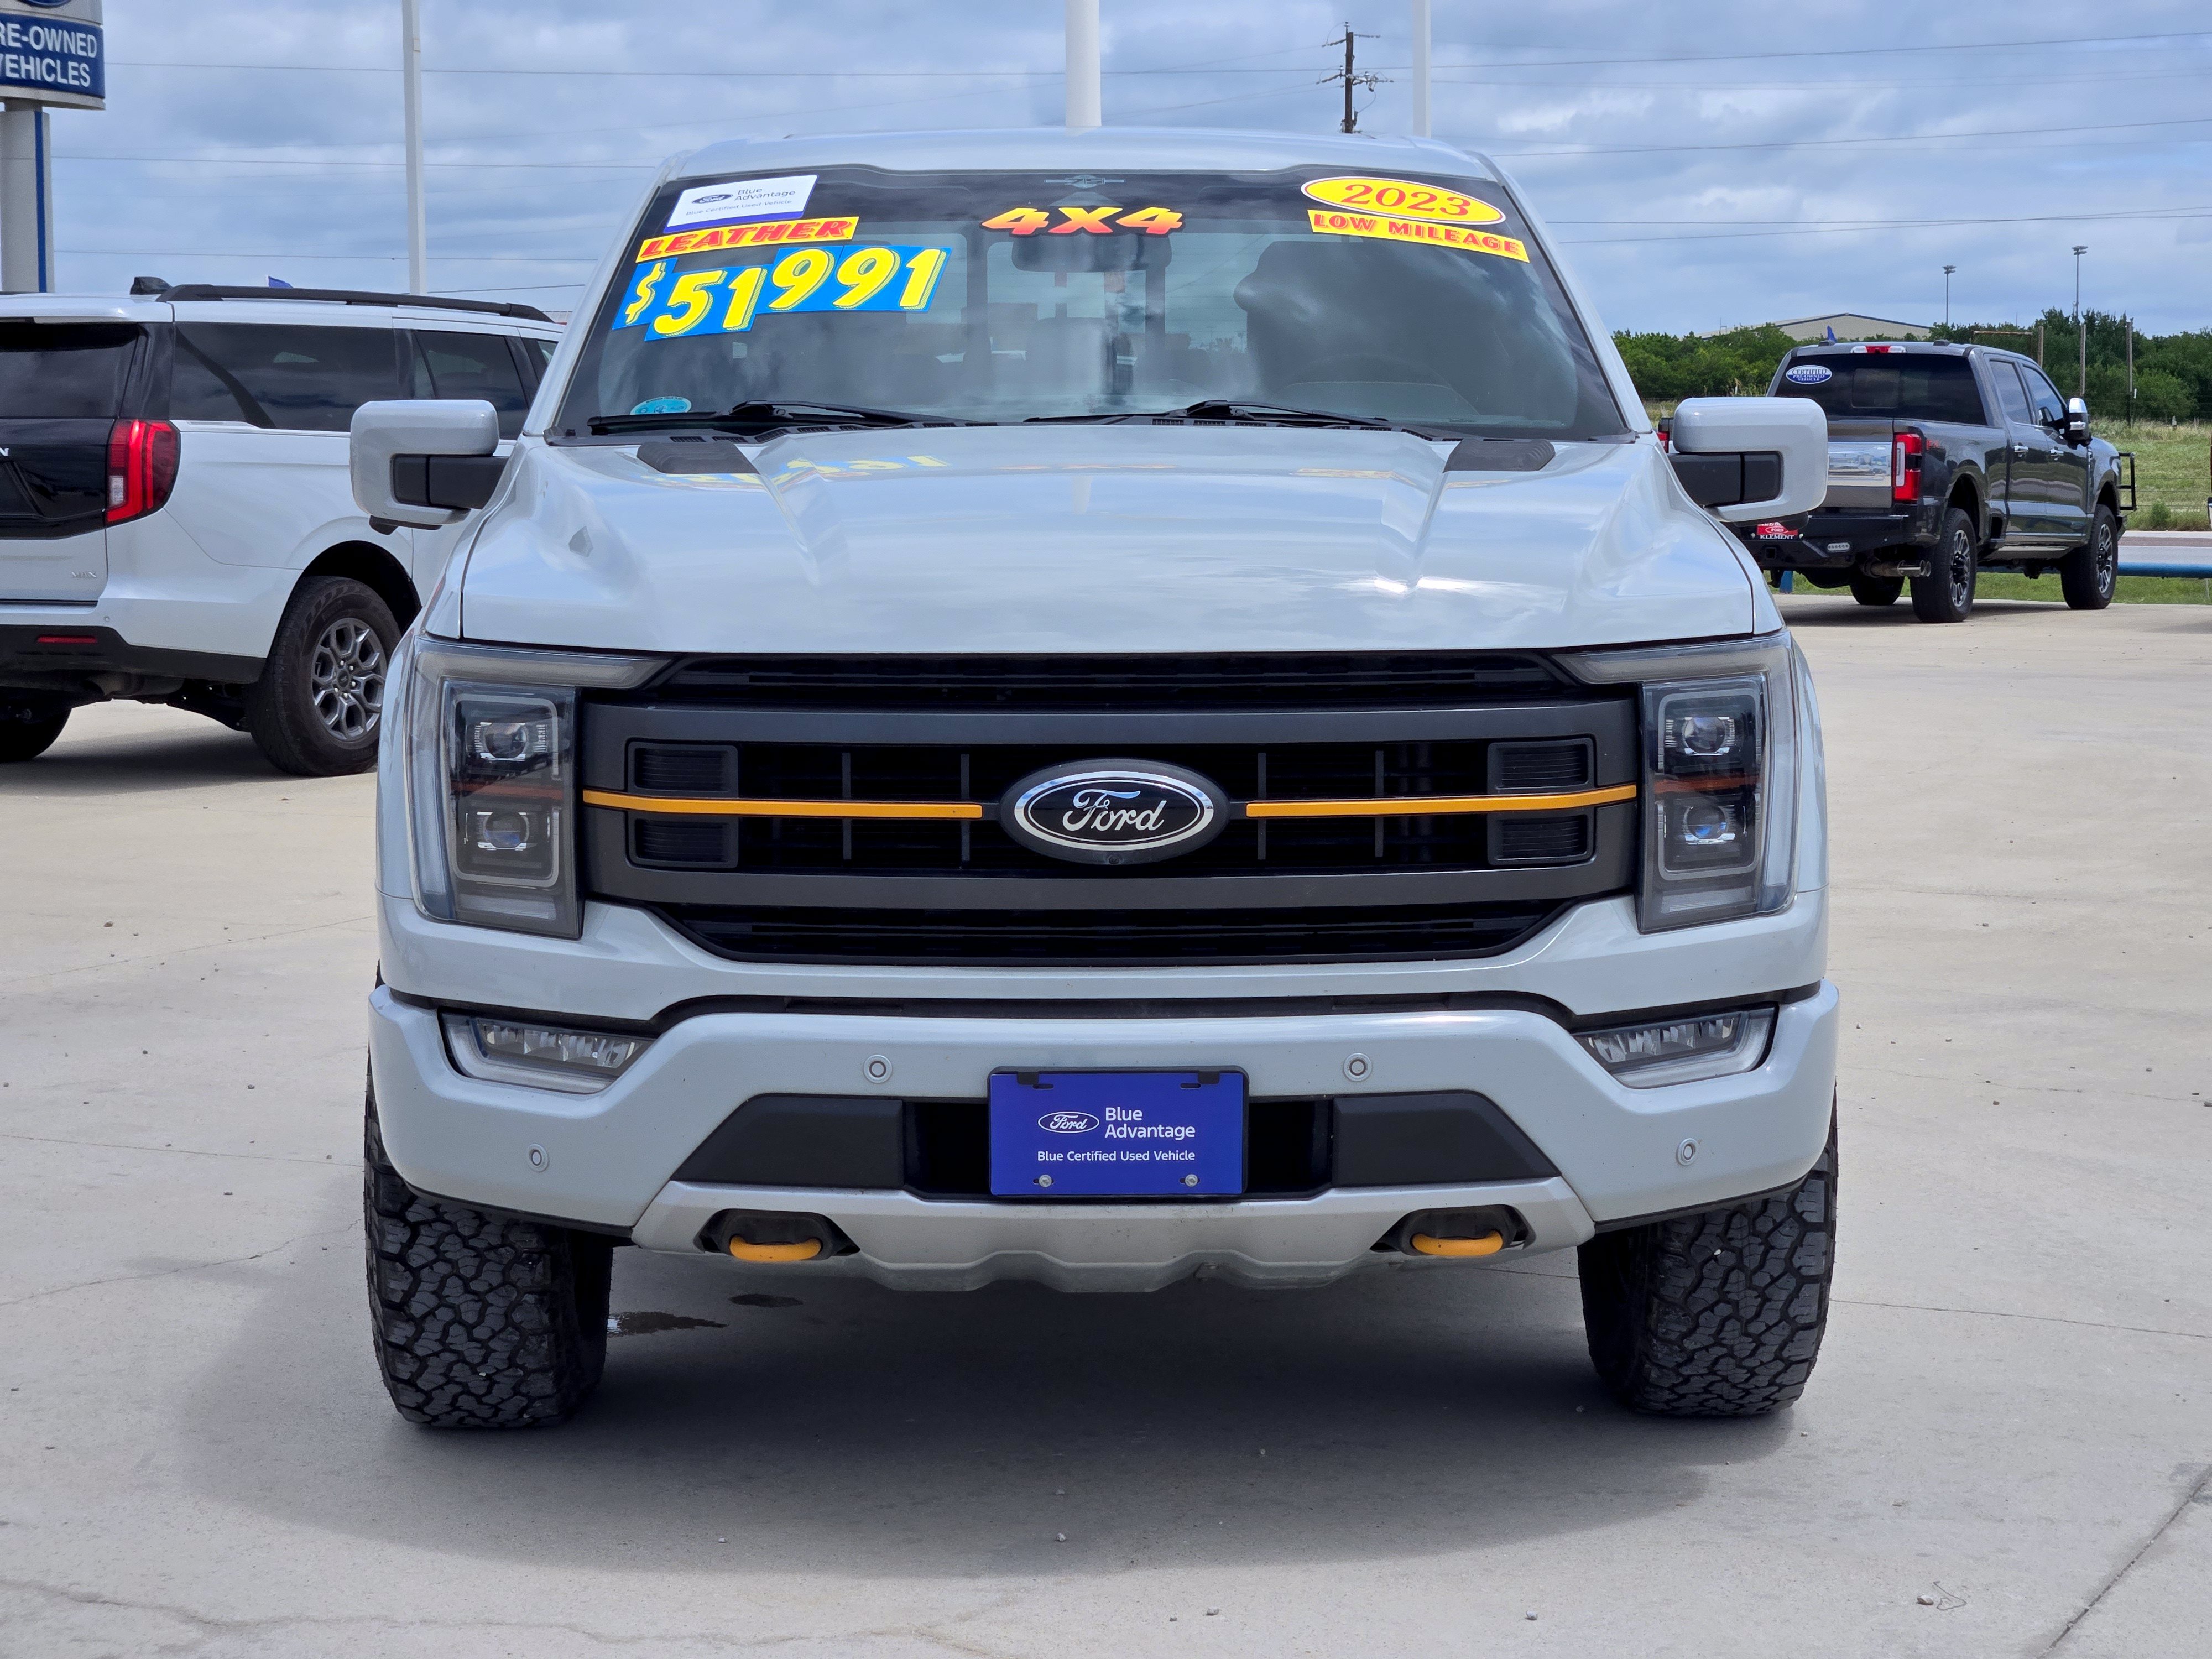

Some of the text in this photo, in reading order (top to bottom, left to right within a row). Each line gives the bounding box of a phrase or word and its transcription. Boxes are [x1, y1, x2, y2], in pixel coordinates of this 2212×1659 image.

[0, 53, 91, 87] EHICLES
[699, 195, 726, 203] Ford
[734, 190, 796, 201] Advantage
[1342, 185, 1471, 216] 2023
[981, 206, 1183, 234] 4X4
[1313, 213, 1523, 254] LOW MILEAGE
[641, 220, 852, 258] LEATHER
[1062, 789, 1167, 832] Ford
[1050, 1106, 1143, 1130] Ford Blue
[1104, 1124, 1196, 1140] Advantage
[1037, 1150, 1196, 1161] Blue Certified Used Vehicle
